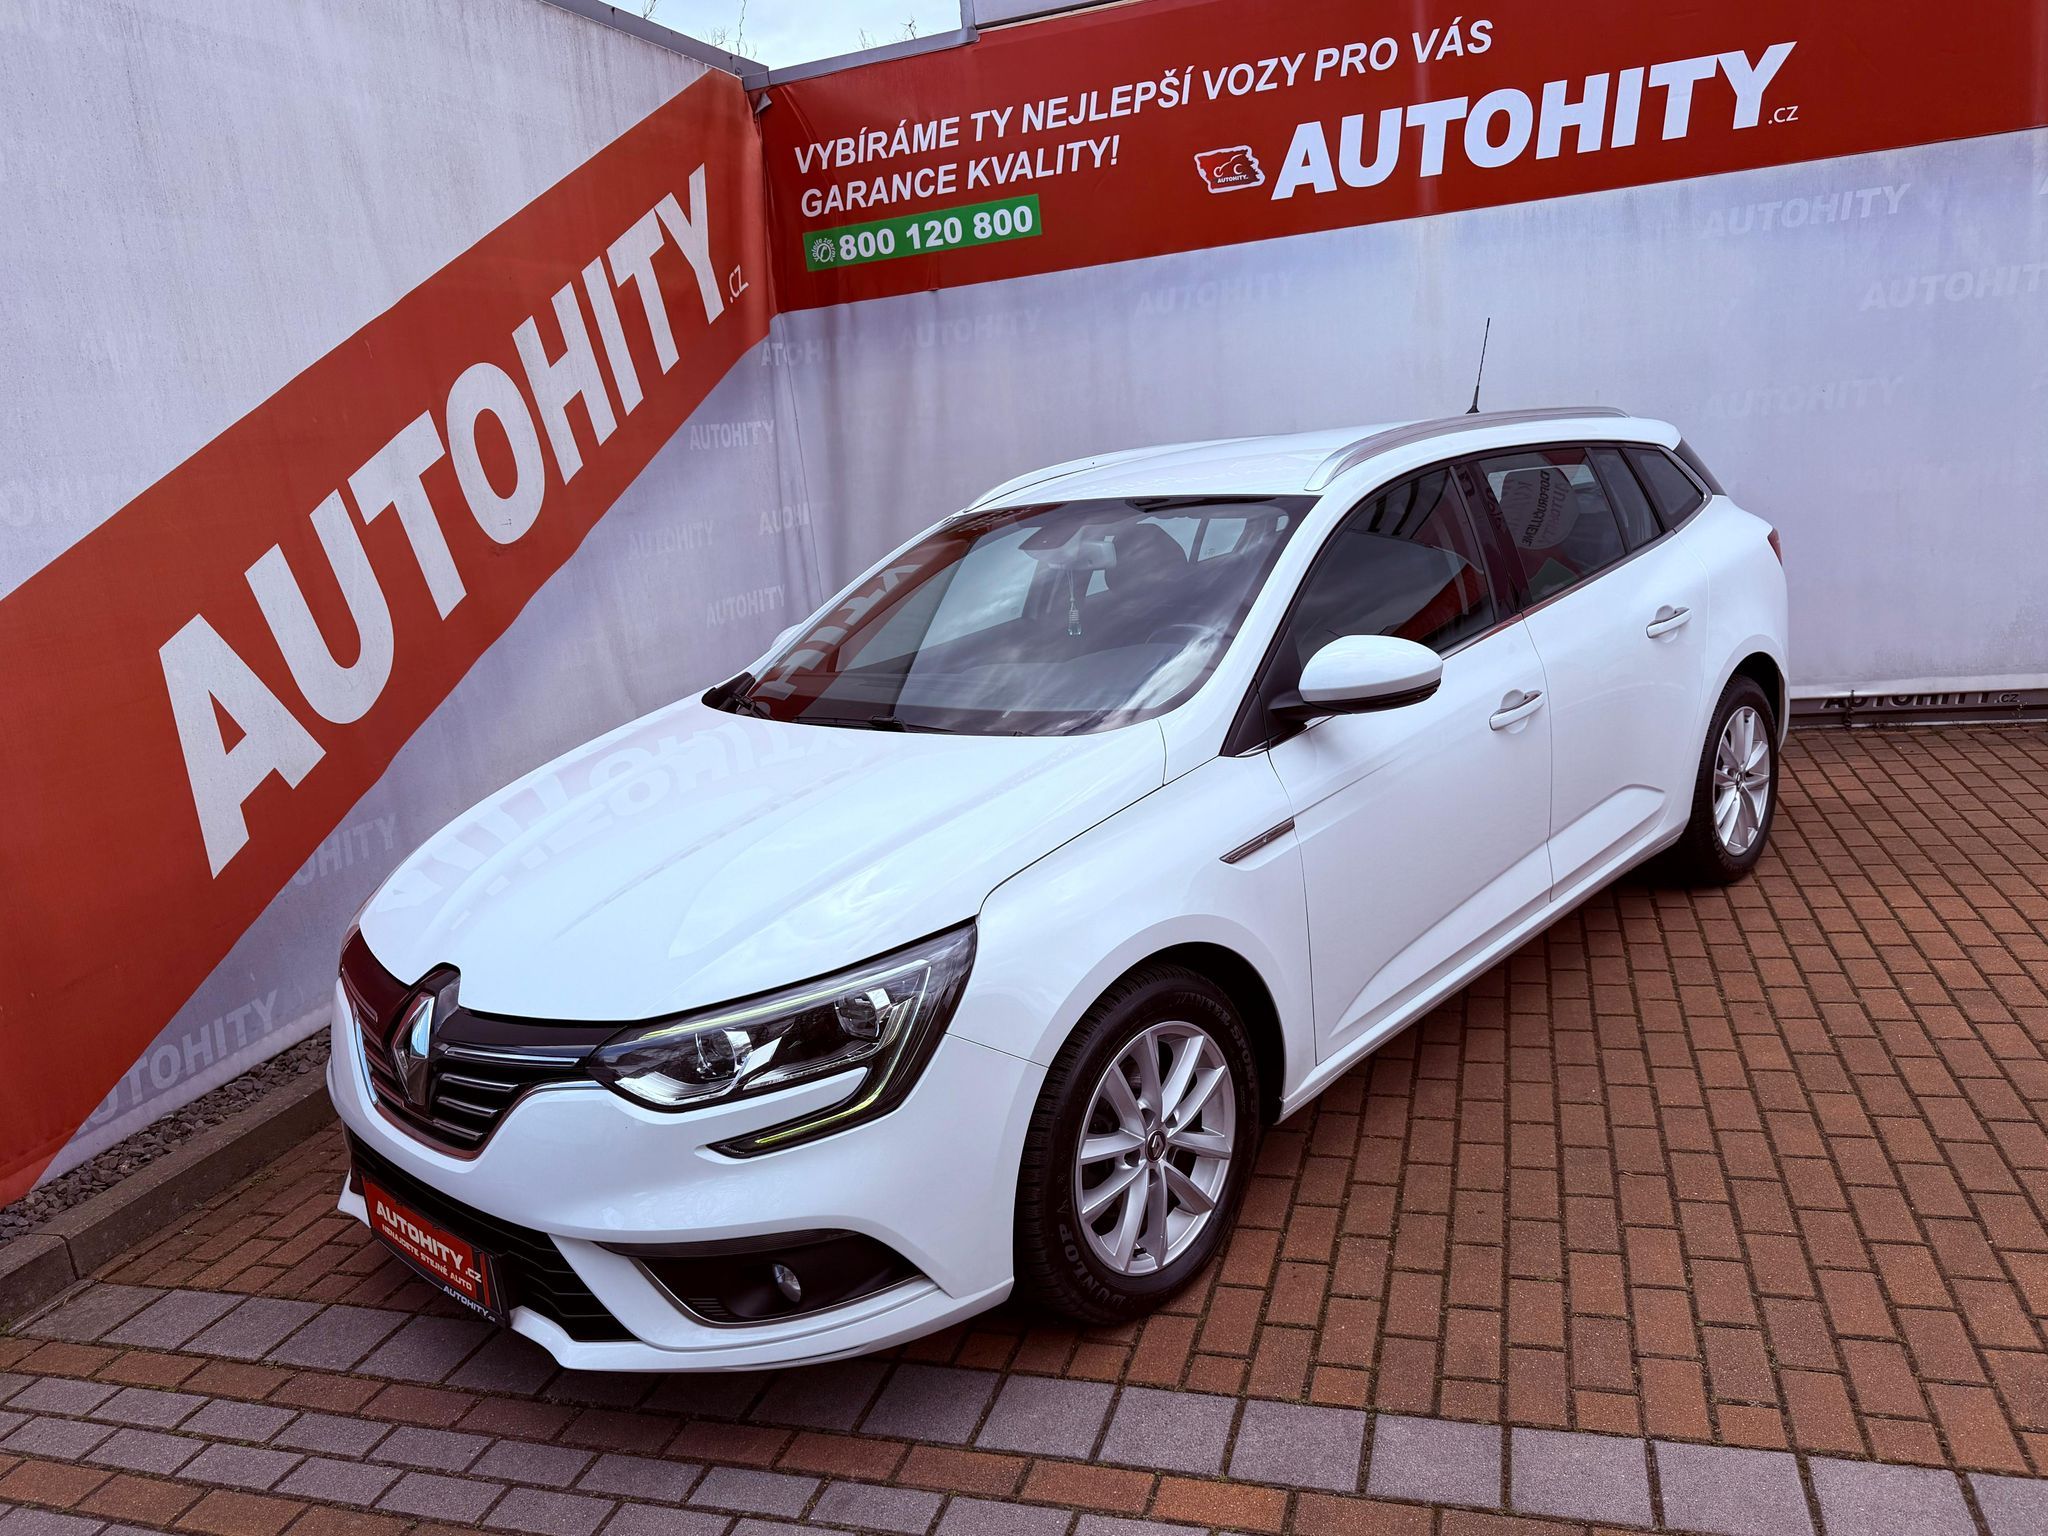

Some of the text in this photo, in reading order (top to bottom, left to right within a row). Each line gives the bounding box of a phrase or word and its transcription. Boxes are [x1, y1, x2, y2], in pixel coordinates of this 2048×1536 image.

[795, 16, 1493, 174] VYBÍRÁME TY NEJLEPŠÍ VOZY PRO VÁS
[1271, 41, 1798, 200] AUTOHITY
[801, 134, 1120, 217] GARANCE KVALITY!
[839, 205, 1033, 261] 800 120 800
[689, 419, 775, 451] AUTOHITY
[159, 163, 725, 880] AUTOHITY
[376, 1199, 464, 1271] AUTOHITY
[443, 1285, 489, 1317] AUTOHITY
[450, 1272, 473, 1291] AUTO
